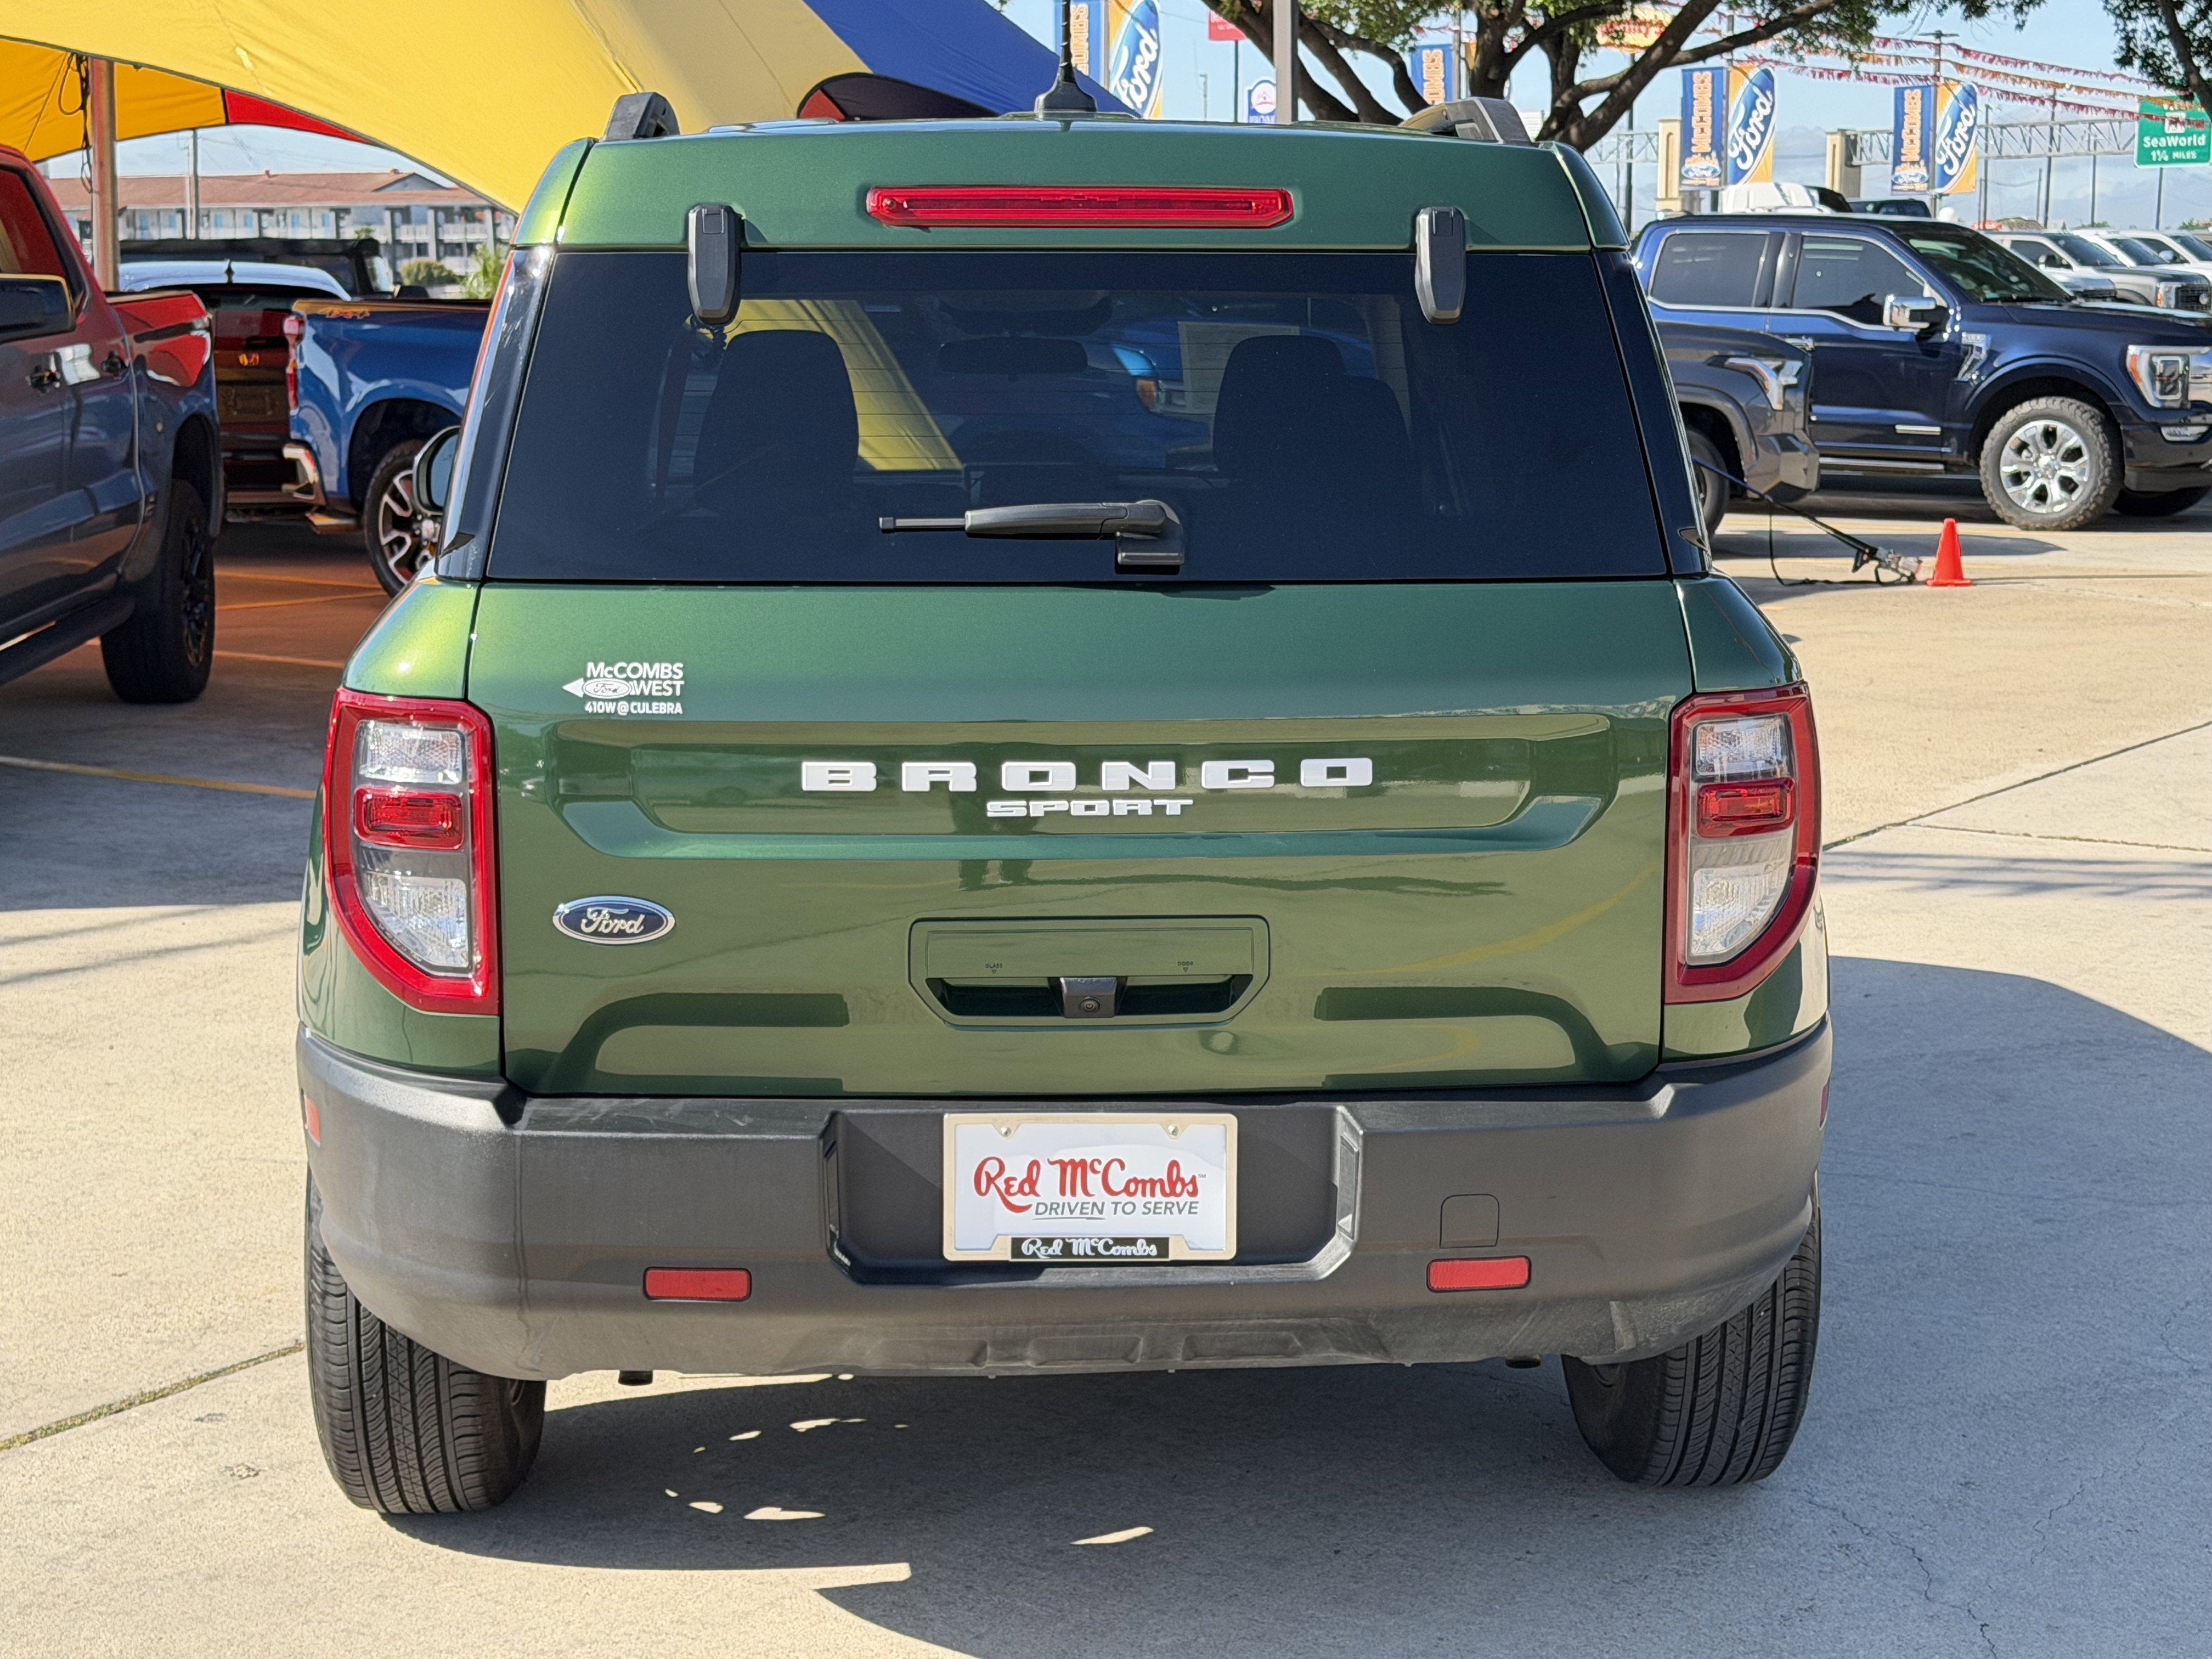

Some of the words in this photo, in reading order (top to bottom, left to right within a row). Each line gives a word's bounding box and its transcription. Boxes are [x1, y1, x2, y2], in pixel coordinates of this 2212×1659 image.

[1728, 86, 1773, 170] Ford
[1936, 100, 1976, 176] Ford
[2143, 134, 2206, 148] SeaWorld
[593, 682, 620, 693] Ford
[632, 680, 685, 696] WEST
[802, 758, 1373, 792] BRONCO
[986, 799, 1193, 817] SPORT
[580, 906, 646, 934] Ford
[974, 1156, 1040, 1213] Red
[1047, 1158, 1198, 1198] McCombs
[1034, 1201, 1105, 1216] DRIVEN
[1111, 1201, 1136, 1215] TO
[1141, 1200, 1199, 1215] SERVE
[1021, 1238, 1063, 1259] Red
